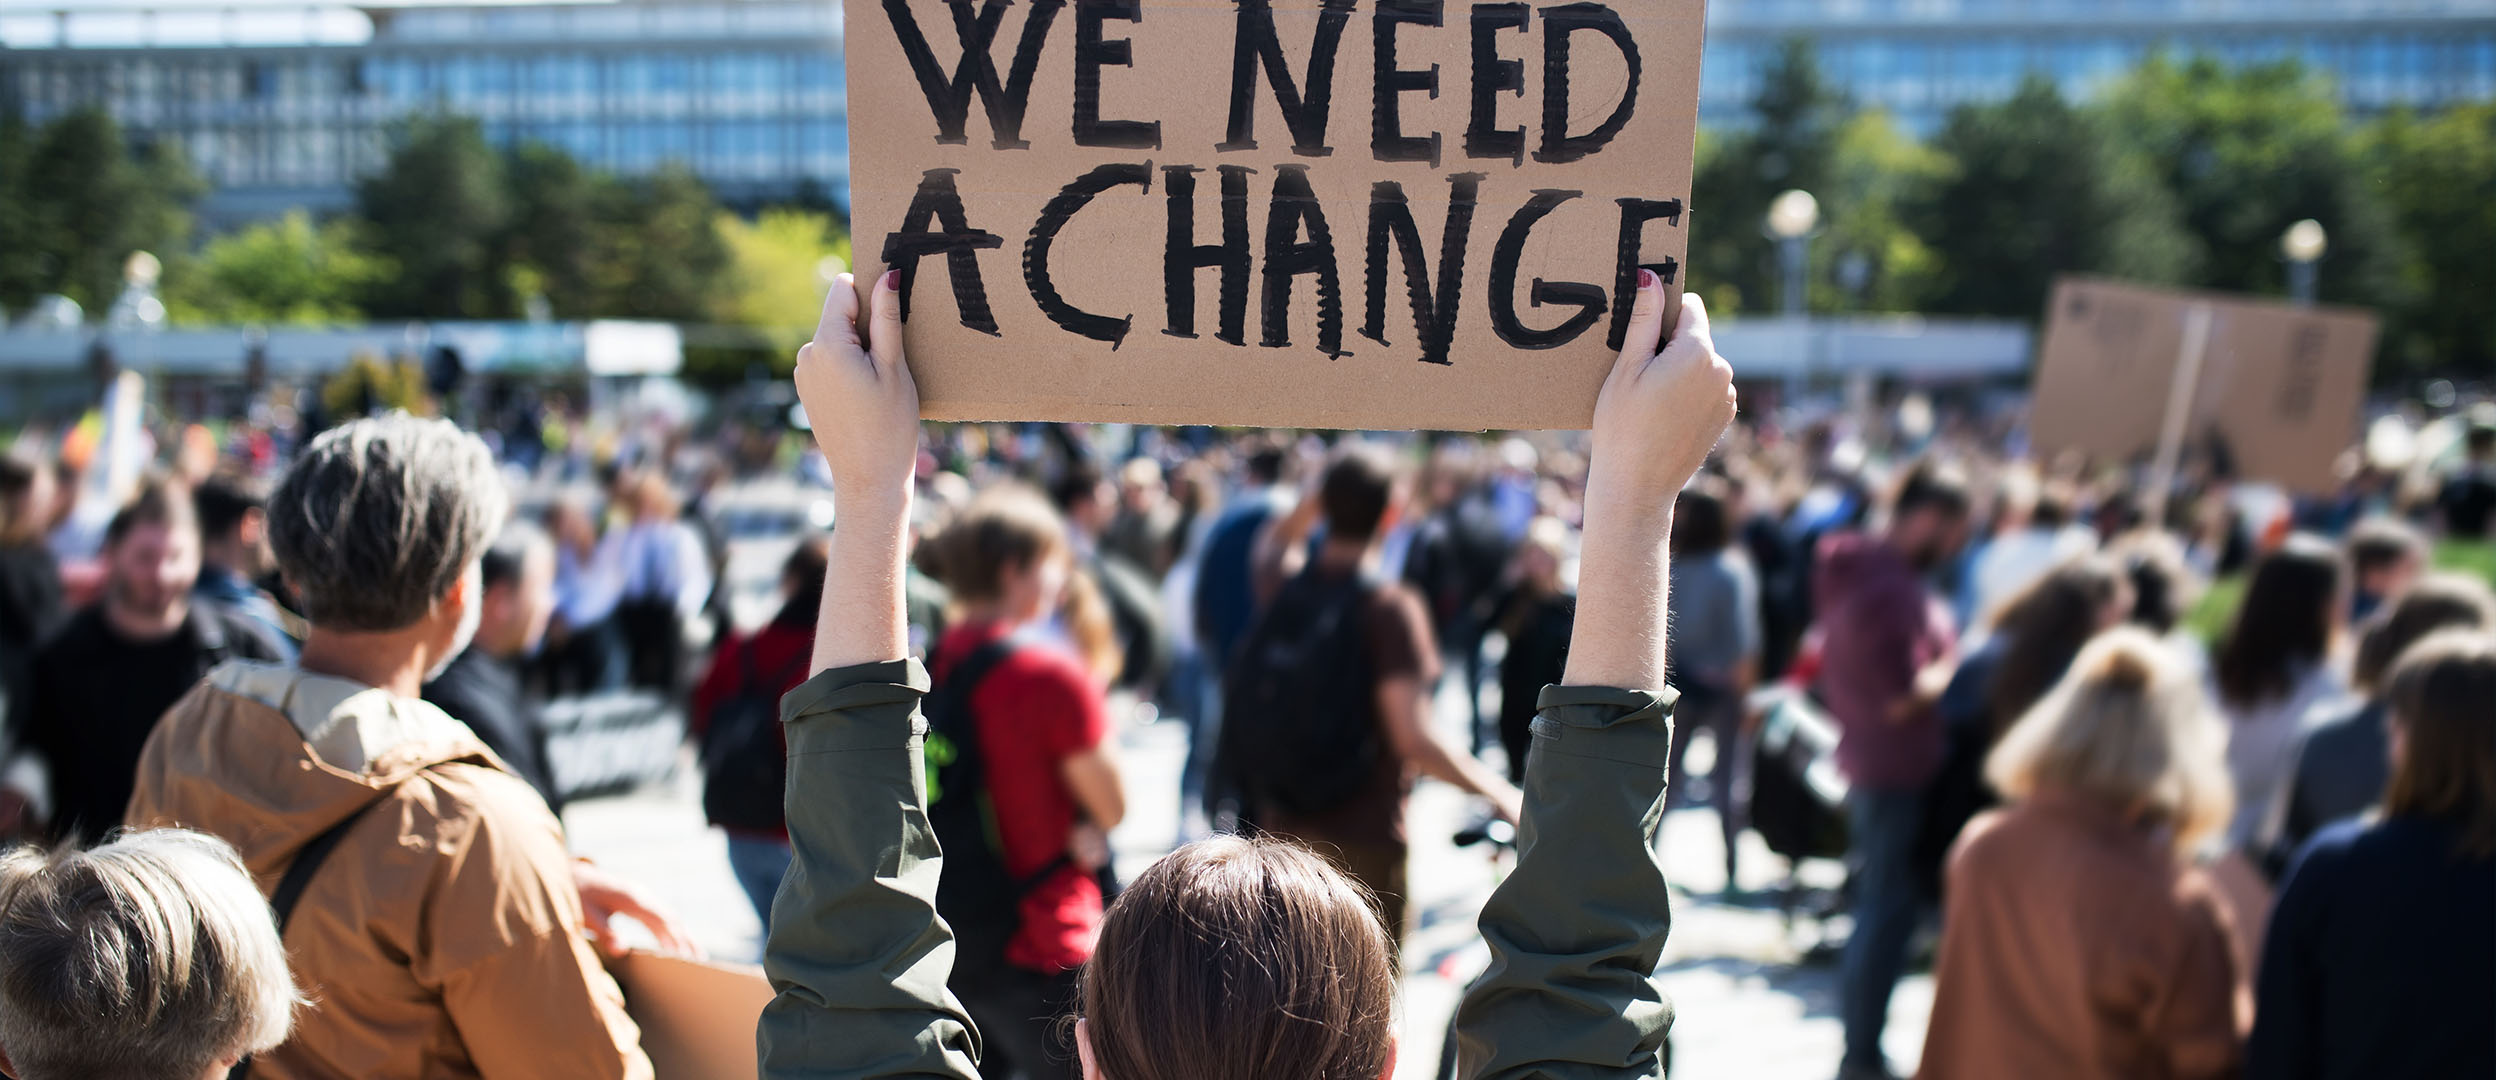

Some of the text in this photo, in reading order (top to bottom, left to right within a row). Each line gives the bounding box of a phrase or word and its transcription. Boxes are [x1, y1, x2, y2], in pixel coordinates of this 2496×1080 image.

[883, 0, 1642, 168] WE NEED
[882, 160, 1682, 366] A CHANGE
